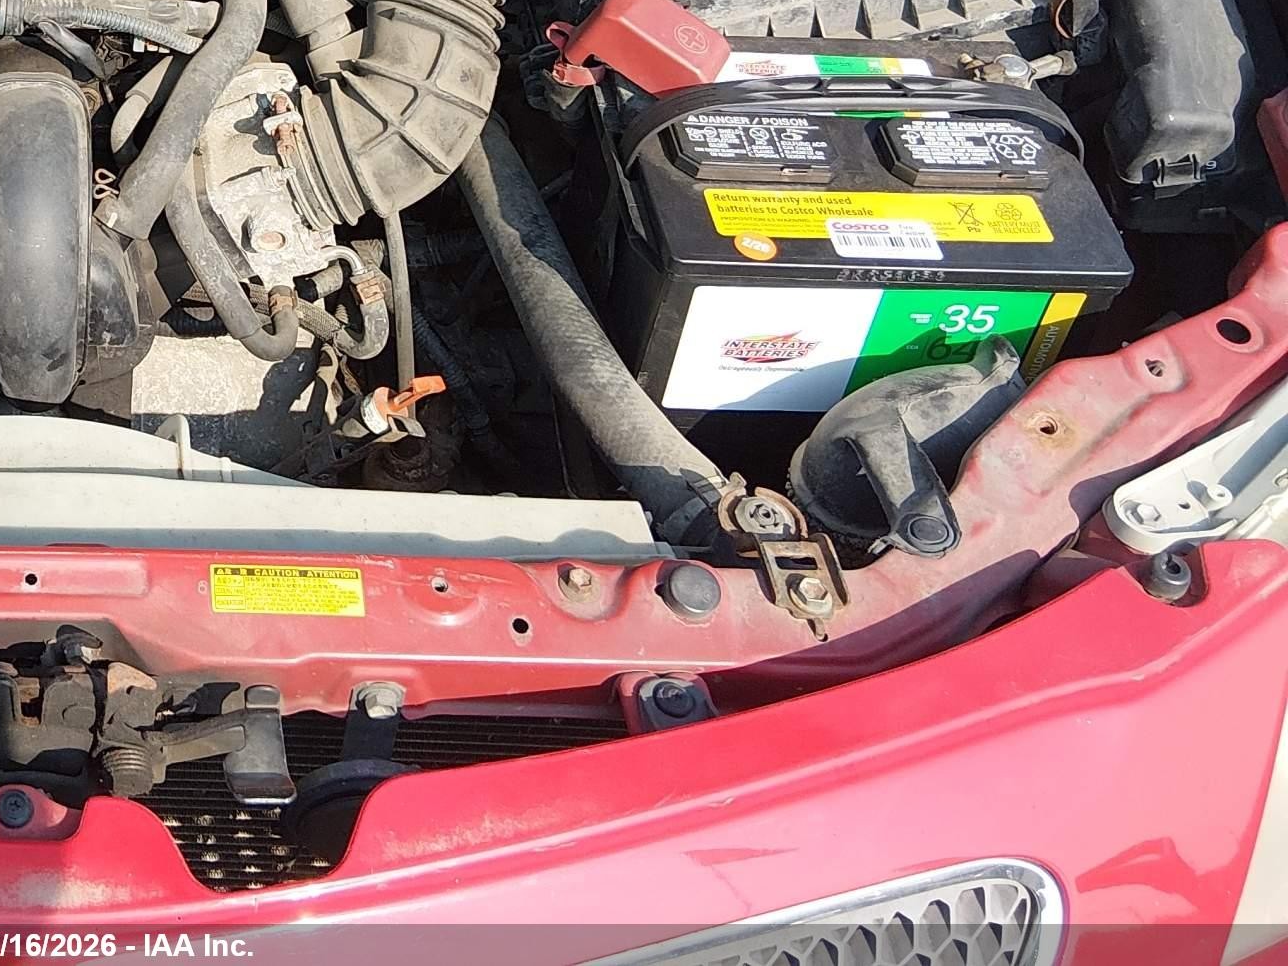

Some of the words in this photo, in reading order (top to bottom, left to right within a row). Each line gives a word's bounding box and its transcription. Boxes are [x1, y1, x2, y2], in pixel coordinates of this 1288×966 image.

[699, 115, 750, 125] DANGER
[761, 117, 809, 127] POISON
[712, 193, 749, 203] Return
[752, 196, 800, 205] warranty
[803, 196, 823, 204] and
[826, 197, 852, 205] used
[717, 205, 765, 214] batteries
[767, 207, 778, 215] to
[780, 207, 815, 215] Costco
[817, 207, 874, 216] Wholesale
[832, 222, 889, 231] COSTCO
[939, 305, 1000, 333] 35
[724, 339, 816, 349] INTERSTATE
[723, 349, 807, 358] BATTERIES
[254, 568, 300, 577] CAUTION
[306, 570, 357, 579] ATTENTION
